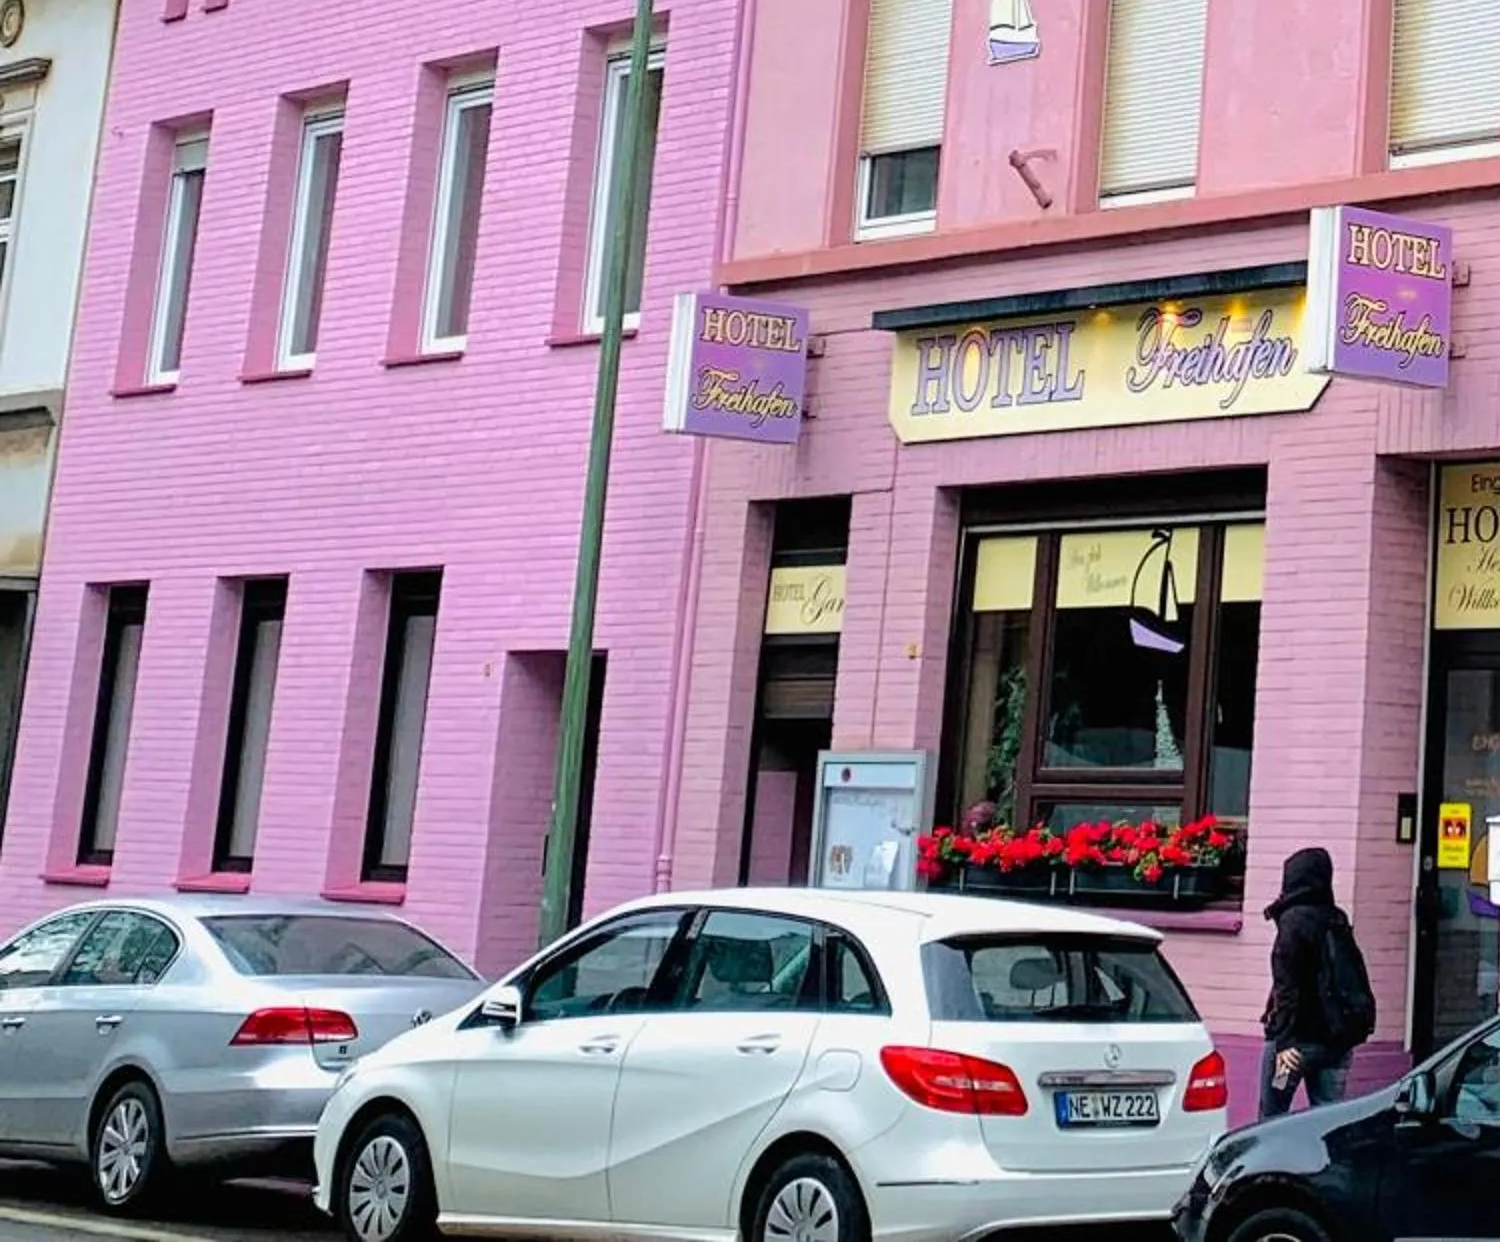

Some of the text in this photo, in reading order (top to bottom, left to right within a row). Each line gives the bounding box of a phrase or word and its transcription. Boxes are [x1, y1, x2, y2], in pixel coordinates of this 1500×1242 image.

[1347, 223, 1447, 281] HOTEL
[701, 306, 802, 352] HOTEL
[1340, 292, 1444, 370] Freihafen
[911, 307, 1300, 416] HOTEL Freihafen
[692, 364, 799, 428] Freihafen
[1069, 1095, 1155, 1118] NE WZ 222
